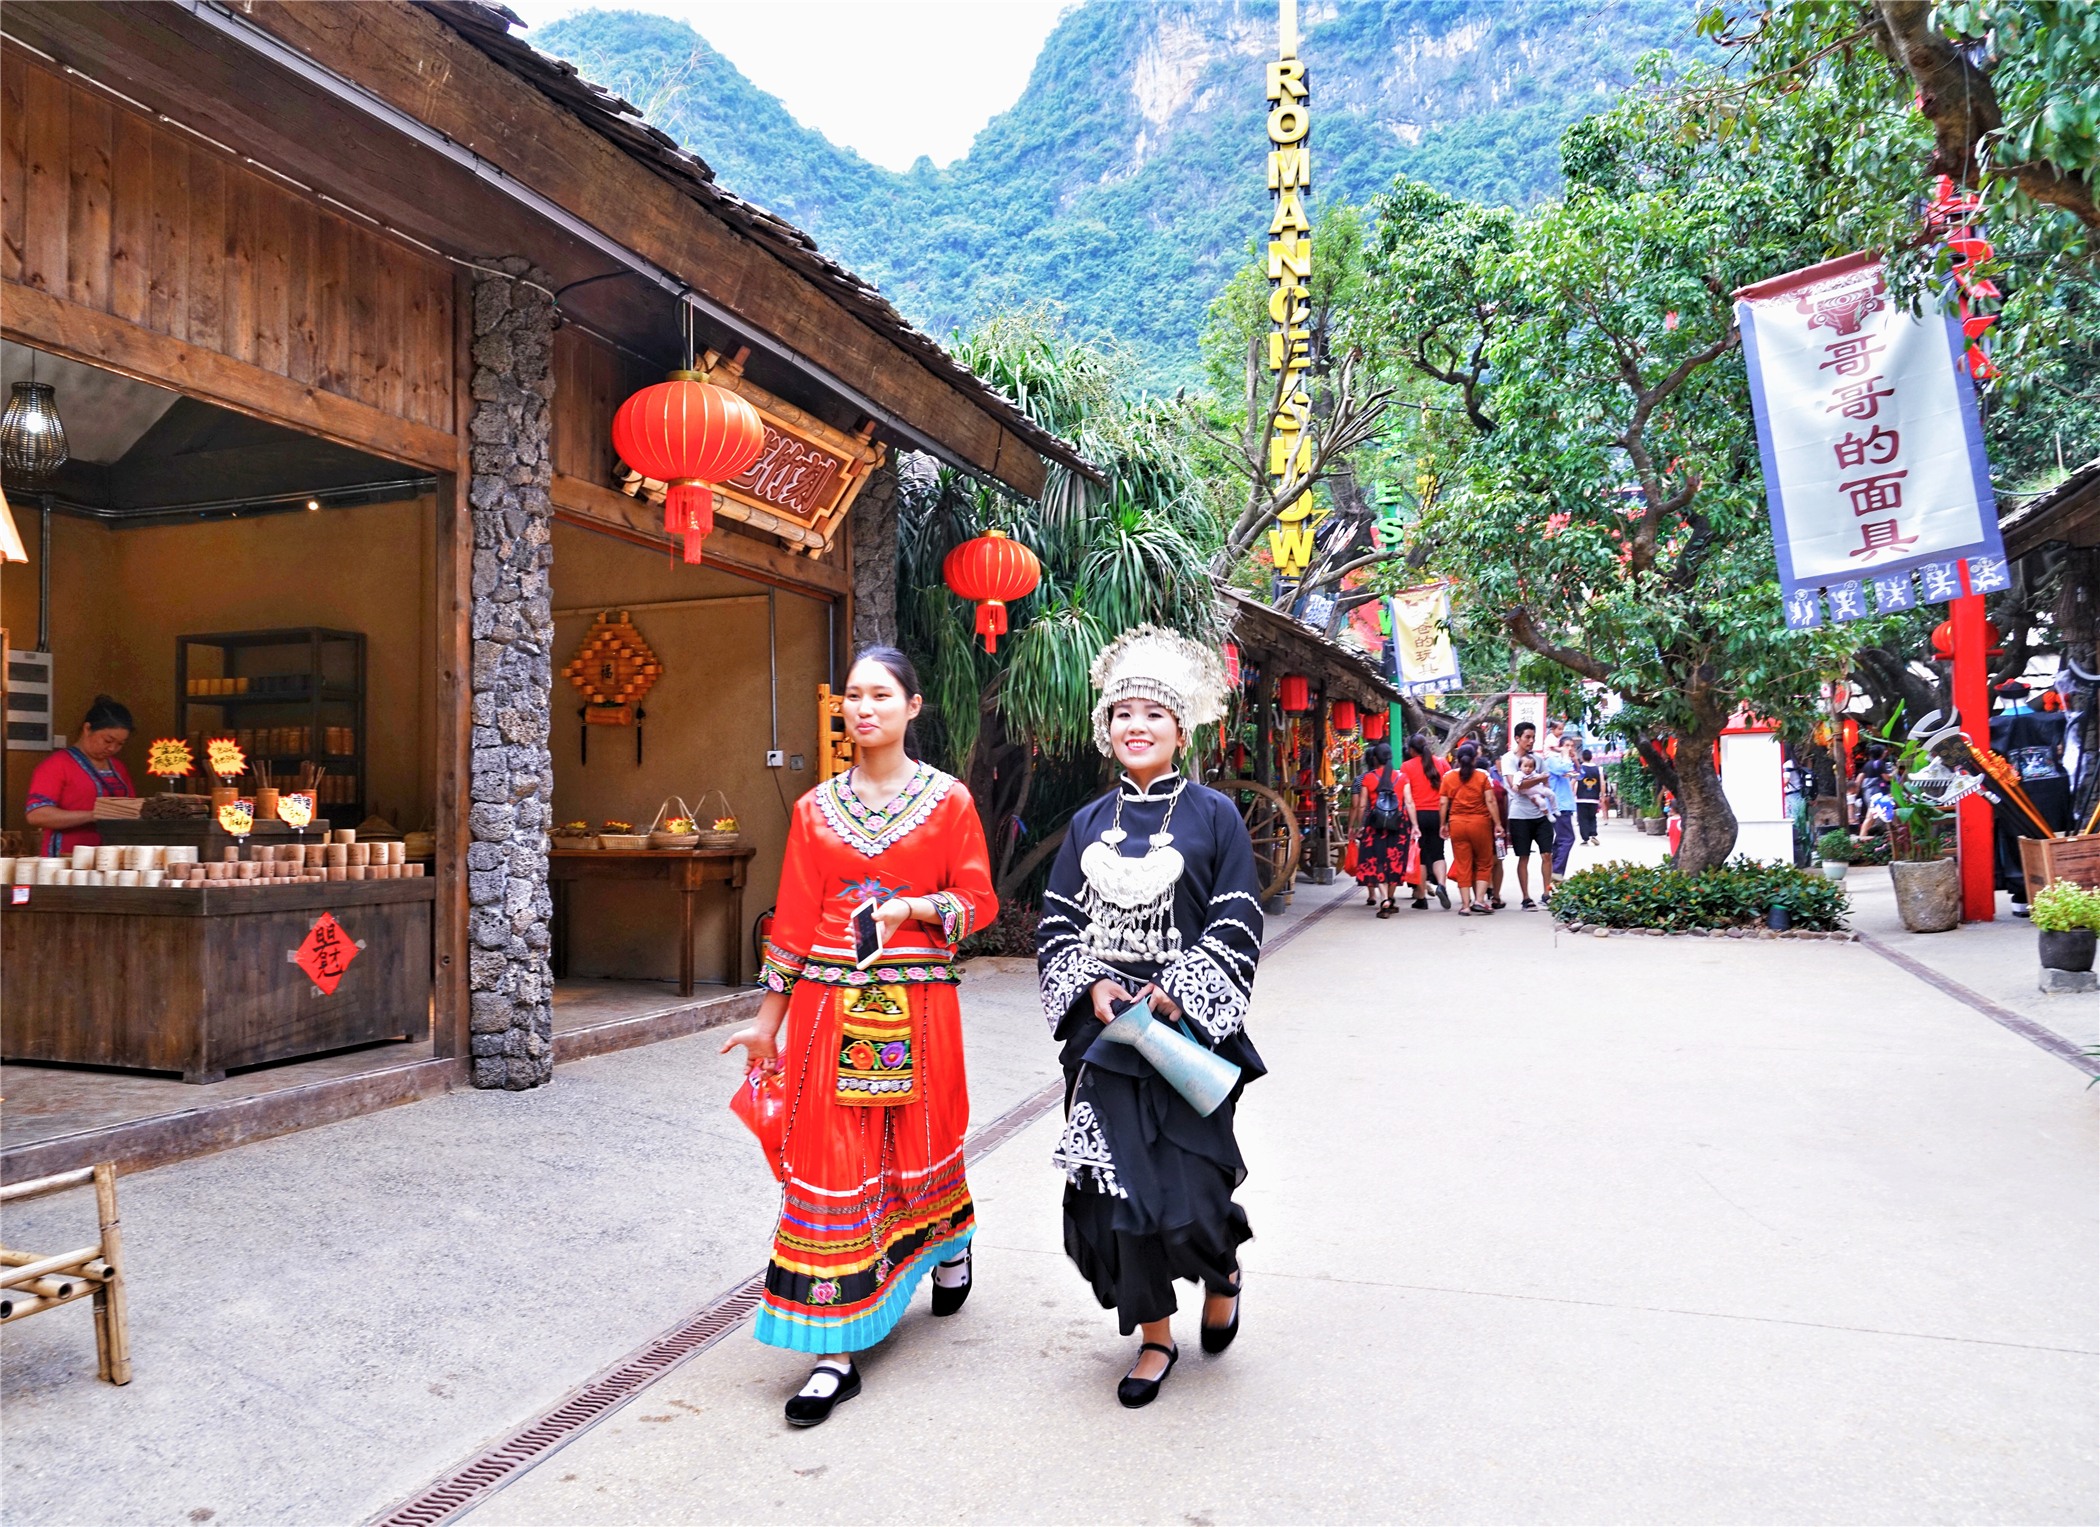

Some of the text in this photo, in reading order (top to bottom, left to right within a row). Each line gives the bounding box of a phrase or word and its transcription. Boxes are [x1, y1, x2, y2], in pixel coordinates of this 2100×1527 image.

[1267, 59, 1316, 568] ROMANCE SHOW
[1819, 333, 1919, 562] 哥哥的面具
